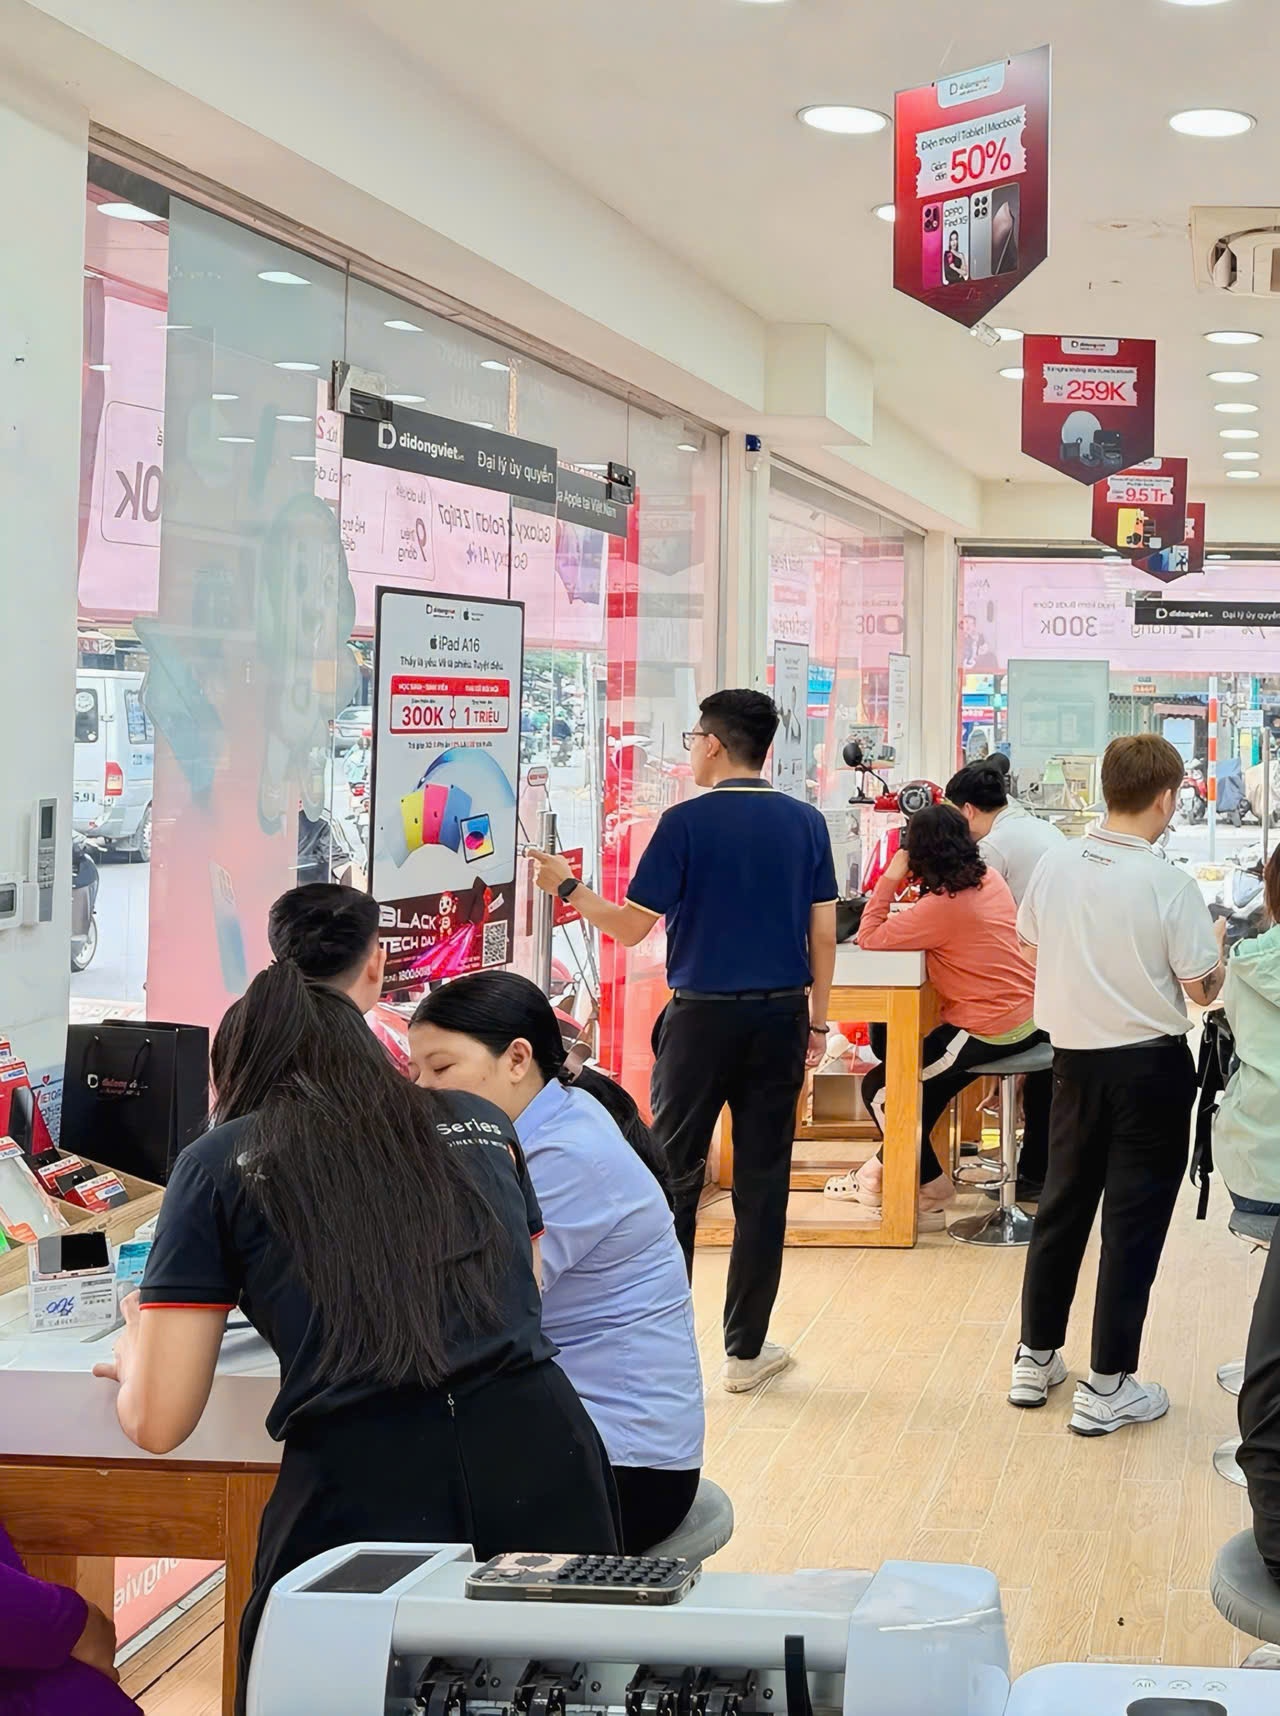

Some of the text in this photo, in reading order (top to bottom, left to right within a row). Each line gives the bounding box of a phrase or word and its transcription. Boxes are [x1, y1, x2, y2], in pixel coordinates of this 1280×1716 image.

[987, 114, 1022, 133] Macbook
[951, 136, 1011, 184] 50%
[944, 206, 963, 217] OPPO
[1067, 380, 1126, 401] 259K
[478, 450, 496, 471] Đại
[497, 454, 508, 476] lý
[524, 464, 554, 486] quyền
[1126, 488, 1149, 502] 9.5
[1150, 488, 1167, 502] Tr
[1222, 610, 1236, 620] Đại
[1237, 611, 1244, 620] lý
[438, 636, 480, 652] iPad A16
[402, 706, 444, 726] 300K
[464, 706, 470, 726] 1
[378, 904, 437, 930] BLACK
[378, 936, 418, 954] TECH
[436, 1118, 502, 1135] Series
